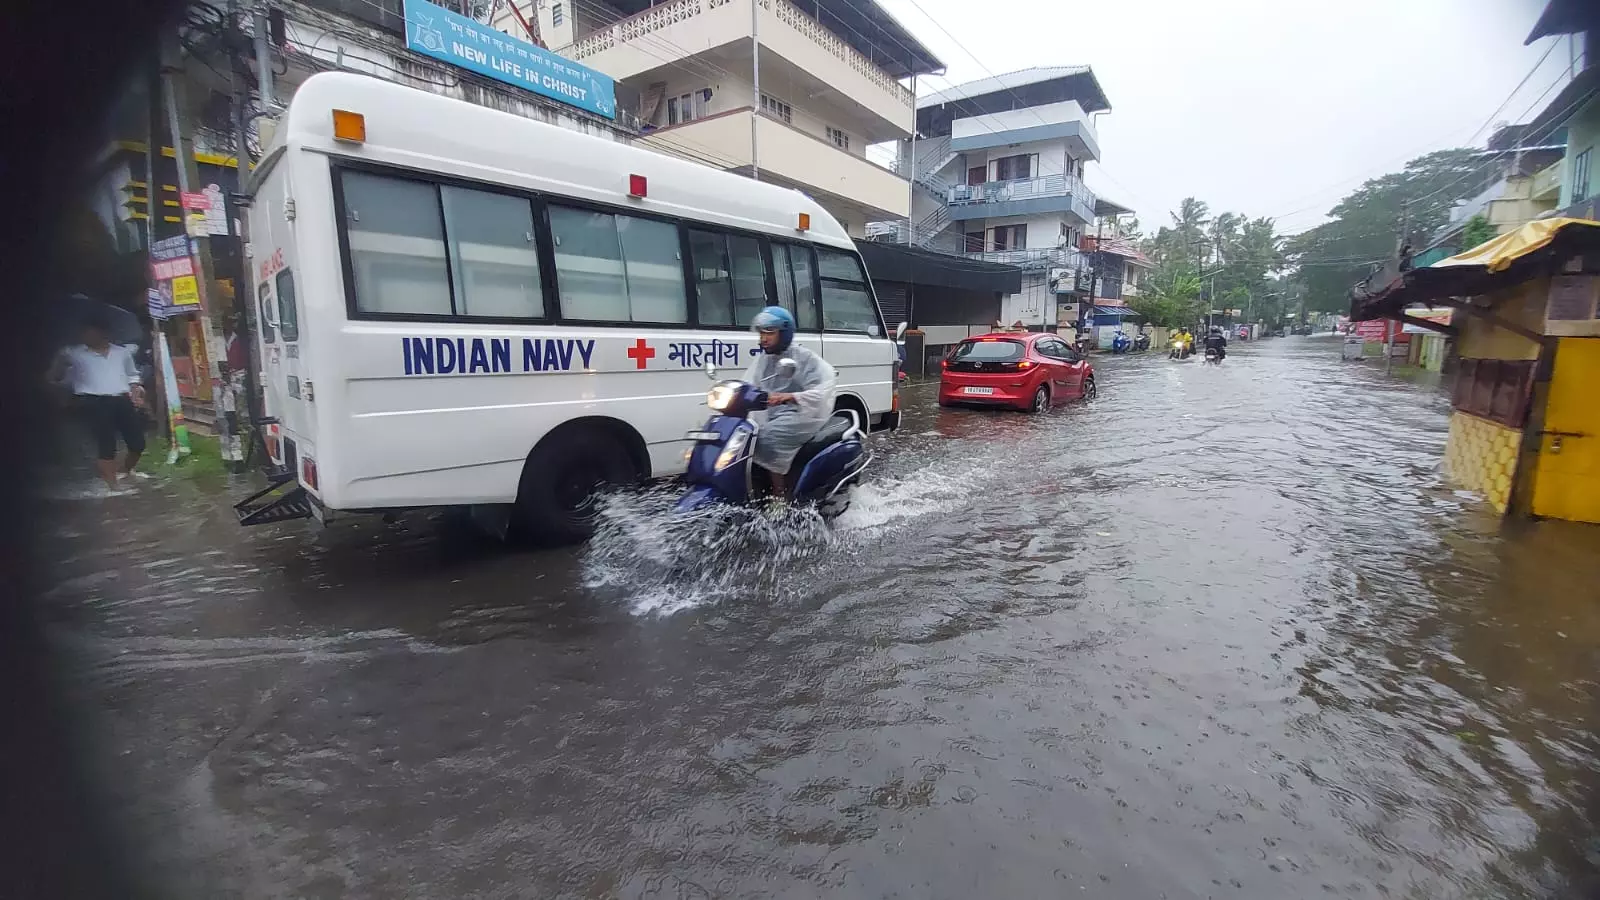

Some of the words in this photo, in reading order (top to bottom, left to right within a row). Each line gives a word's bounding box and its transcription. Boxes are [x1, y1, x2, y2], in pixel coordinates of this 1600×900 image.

[453, 42, 486, 65] NEW
[542, 75, 586, 101] CHRIST
[402, 337, 511, 376] INDIAN
[523, 338, 595, 372] NAVY
[668, 338, 739, 368] भारतीय
